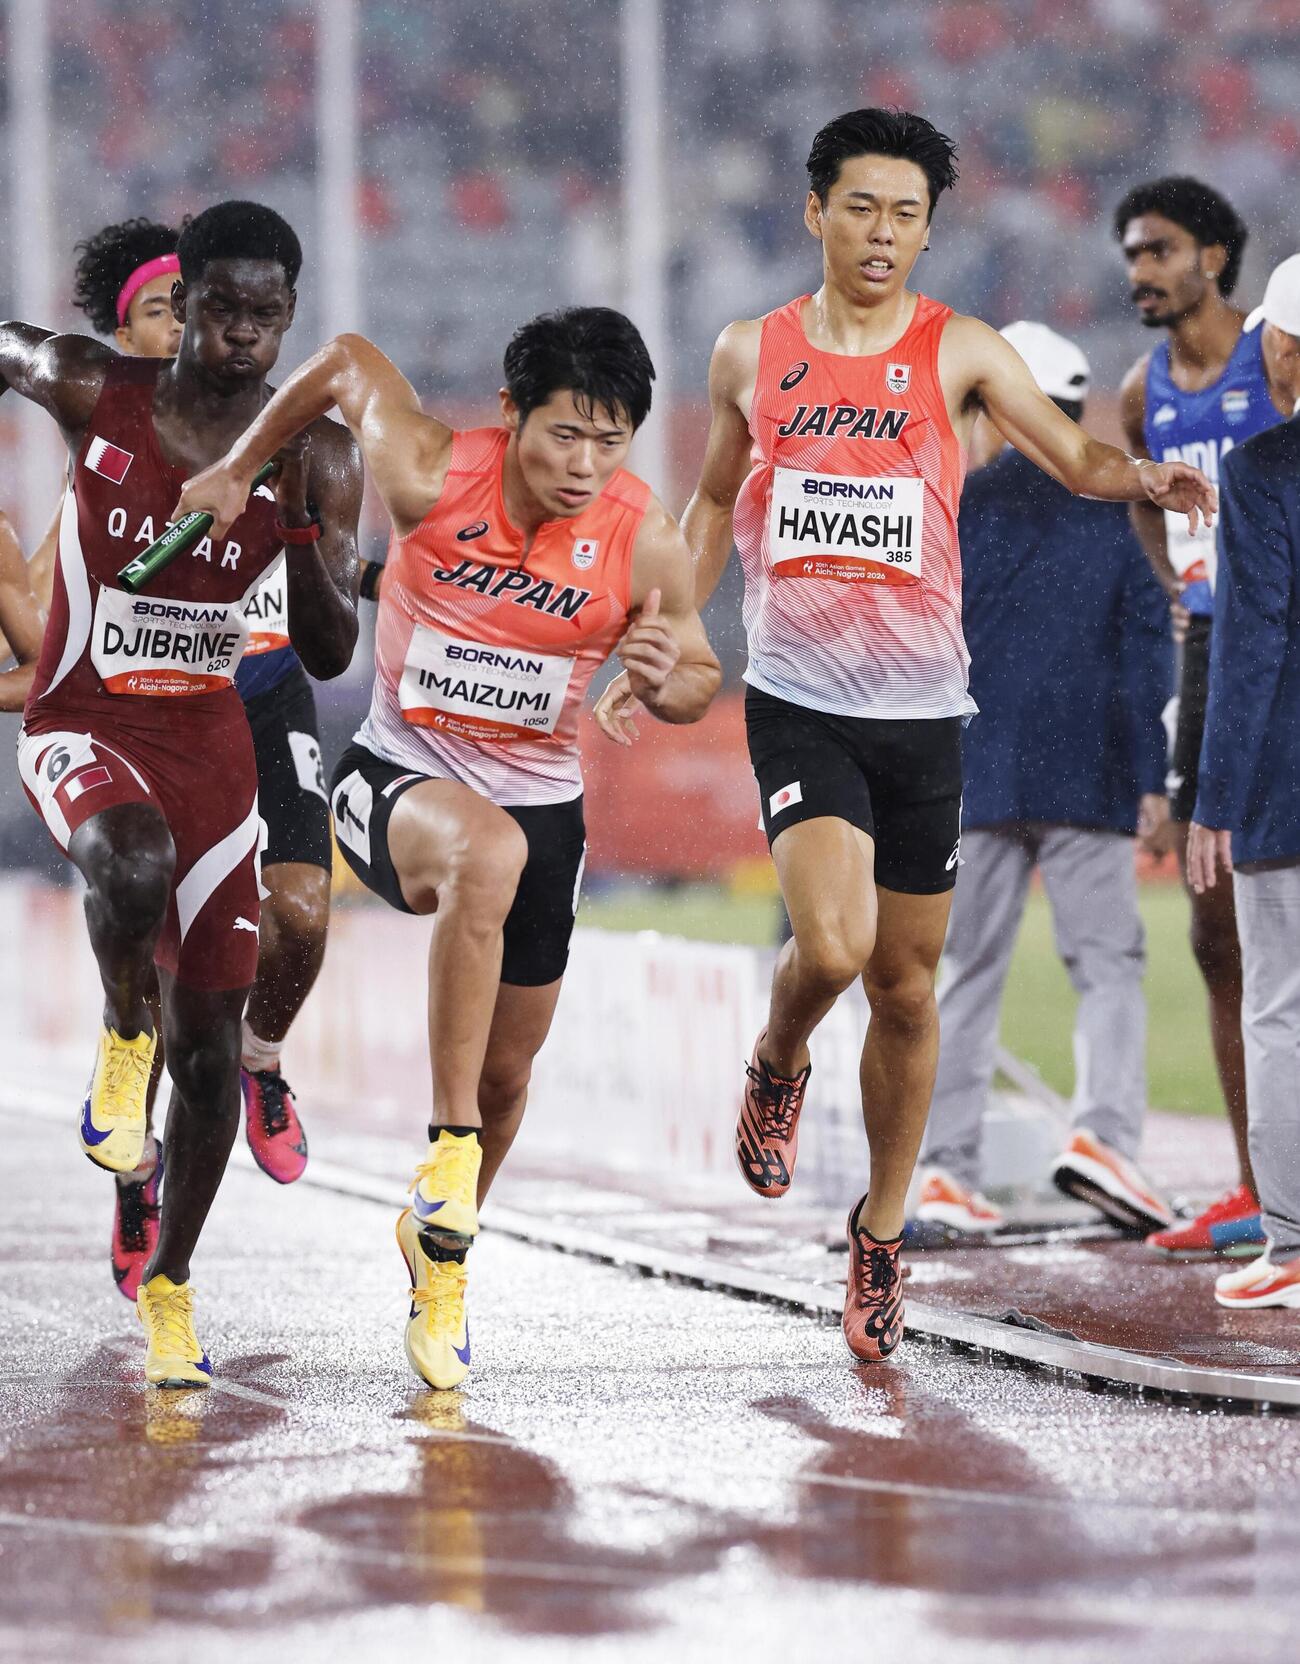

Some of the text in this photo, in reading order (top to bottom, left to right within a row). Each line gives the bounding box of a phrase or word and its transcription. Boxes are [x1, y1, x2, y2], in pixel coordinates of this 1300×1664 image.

[778, 405, 910, 440] JAPAN
[802, 479, 894, 500] BORNAN
[804, 496, 893, 510] SPORTS TECHNOLOGY
[108, 508, 241, 570] QAAR
[161, 511, 202, 546] goya 2026
[778, 506, 913, 548] HAYASHI
[886, 551, 912, 563] 385
[867, 572, 886, 580] 2026
[243, 589, 282, 618] AN
[433, 560, 593, 621] JAPAN
[132, 602, 228, 622] BORNAN
[132, 616, 225, 631] SPORTS TECHNOLOGY
[103, 622, 240, 663] DJIBRINE
[207, 659, 230, 673] 620
[444, 659, 541, 682] SPORTS TECHNOLOGY
[445, 645, 543, 675] BORNAN
[139, 683, 188, 694] Aichi-Nagoya
[419, 669, 551, 711] IMAIZUMI
[522, 717, 549, 727] 1050
[47, 746, 71, 782] 6
